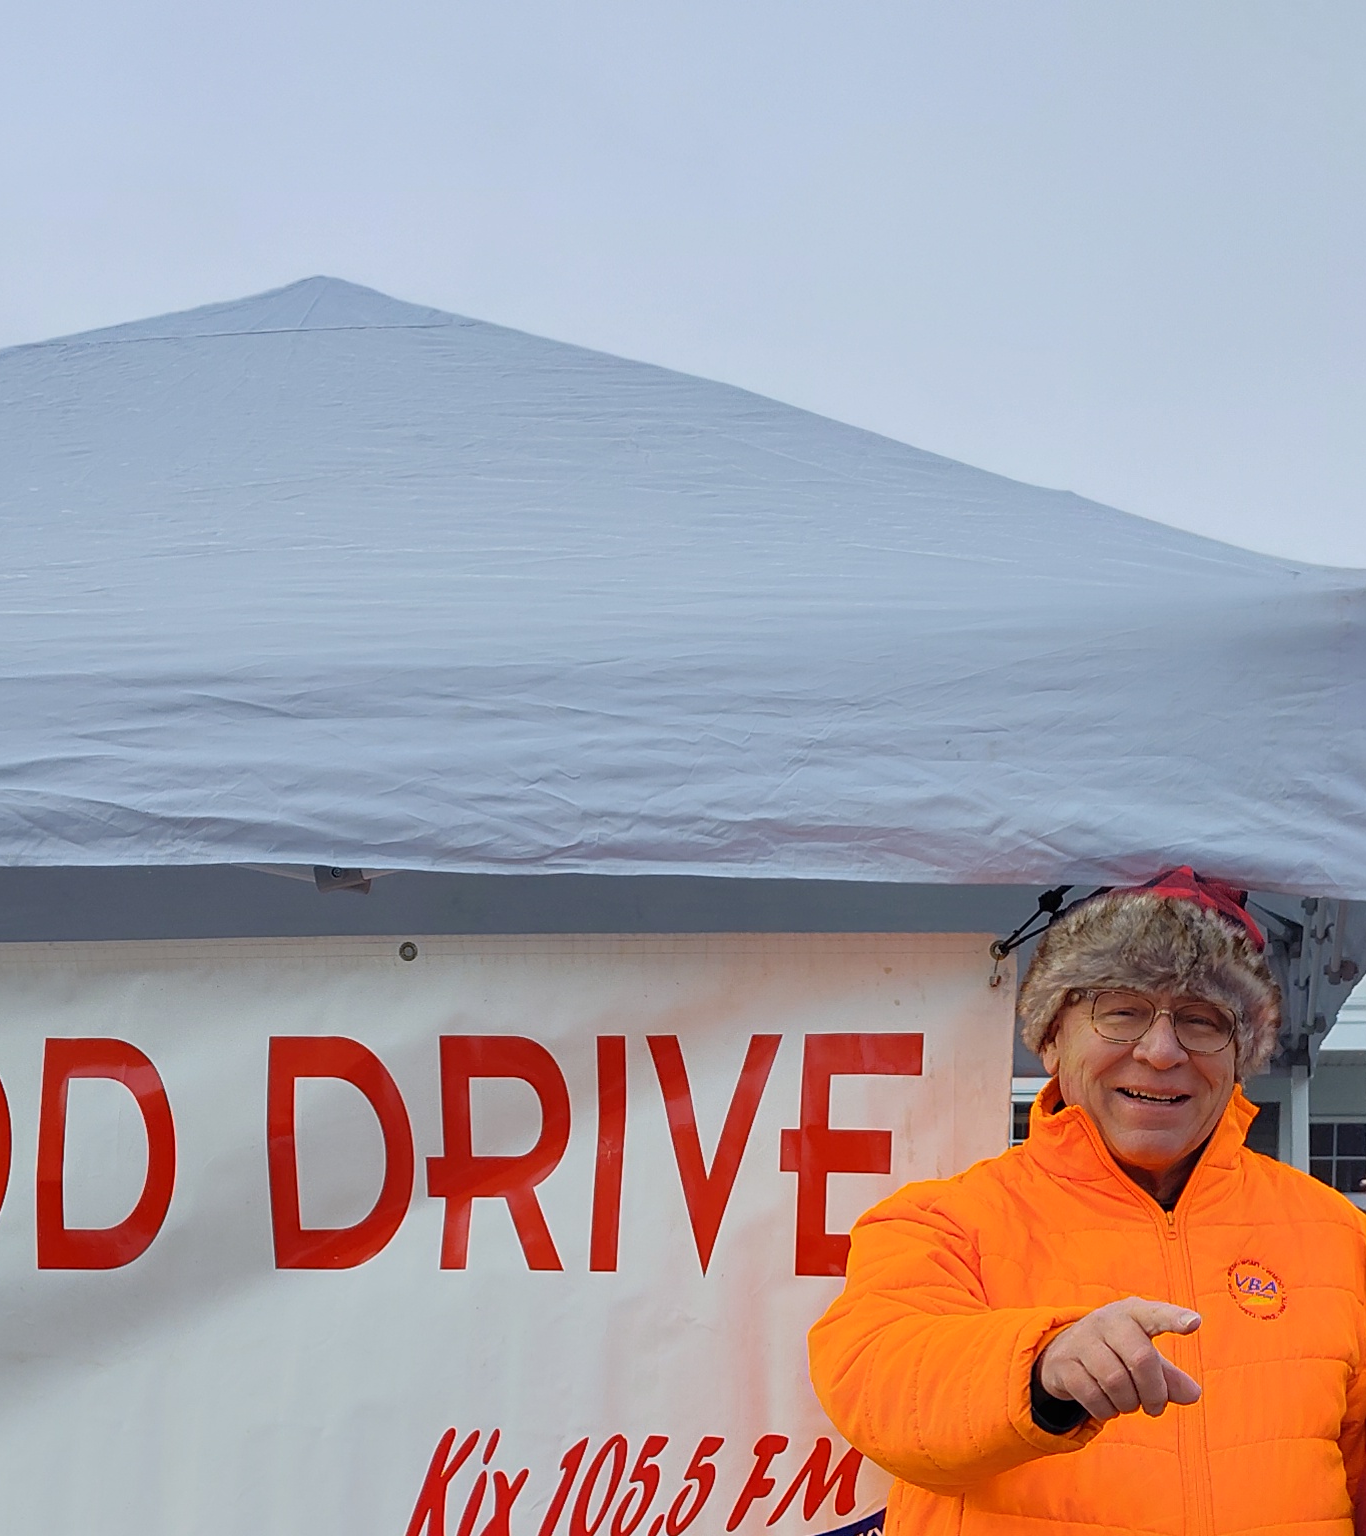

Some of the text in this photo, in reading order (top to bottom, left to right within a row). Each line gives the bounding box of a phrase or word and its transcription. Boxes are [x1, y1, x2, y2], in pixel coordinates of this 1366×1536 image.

[267, 1032, 924, 1278] DRIVE
[1235, 1273, 1277, 1294] VBA
[726, 1434, 864, 1533] FM
